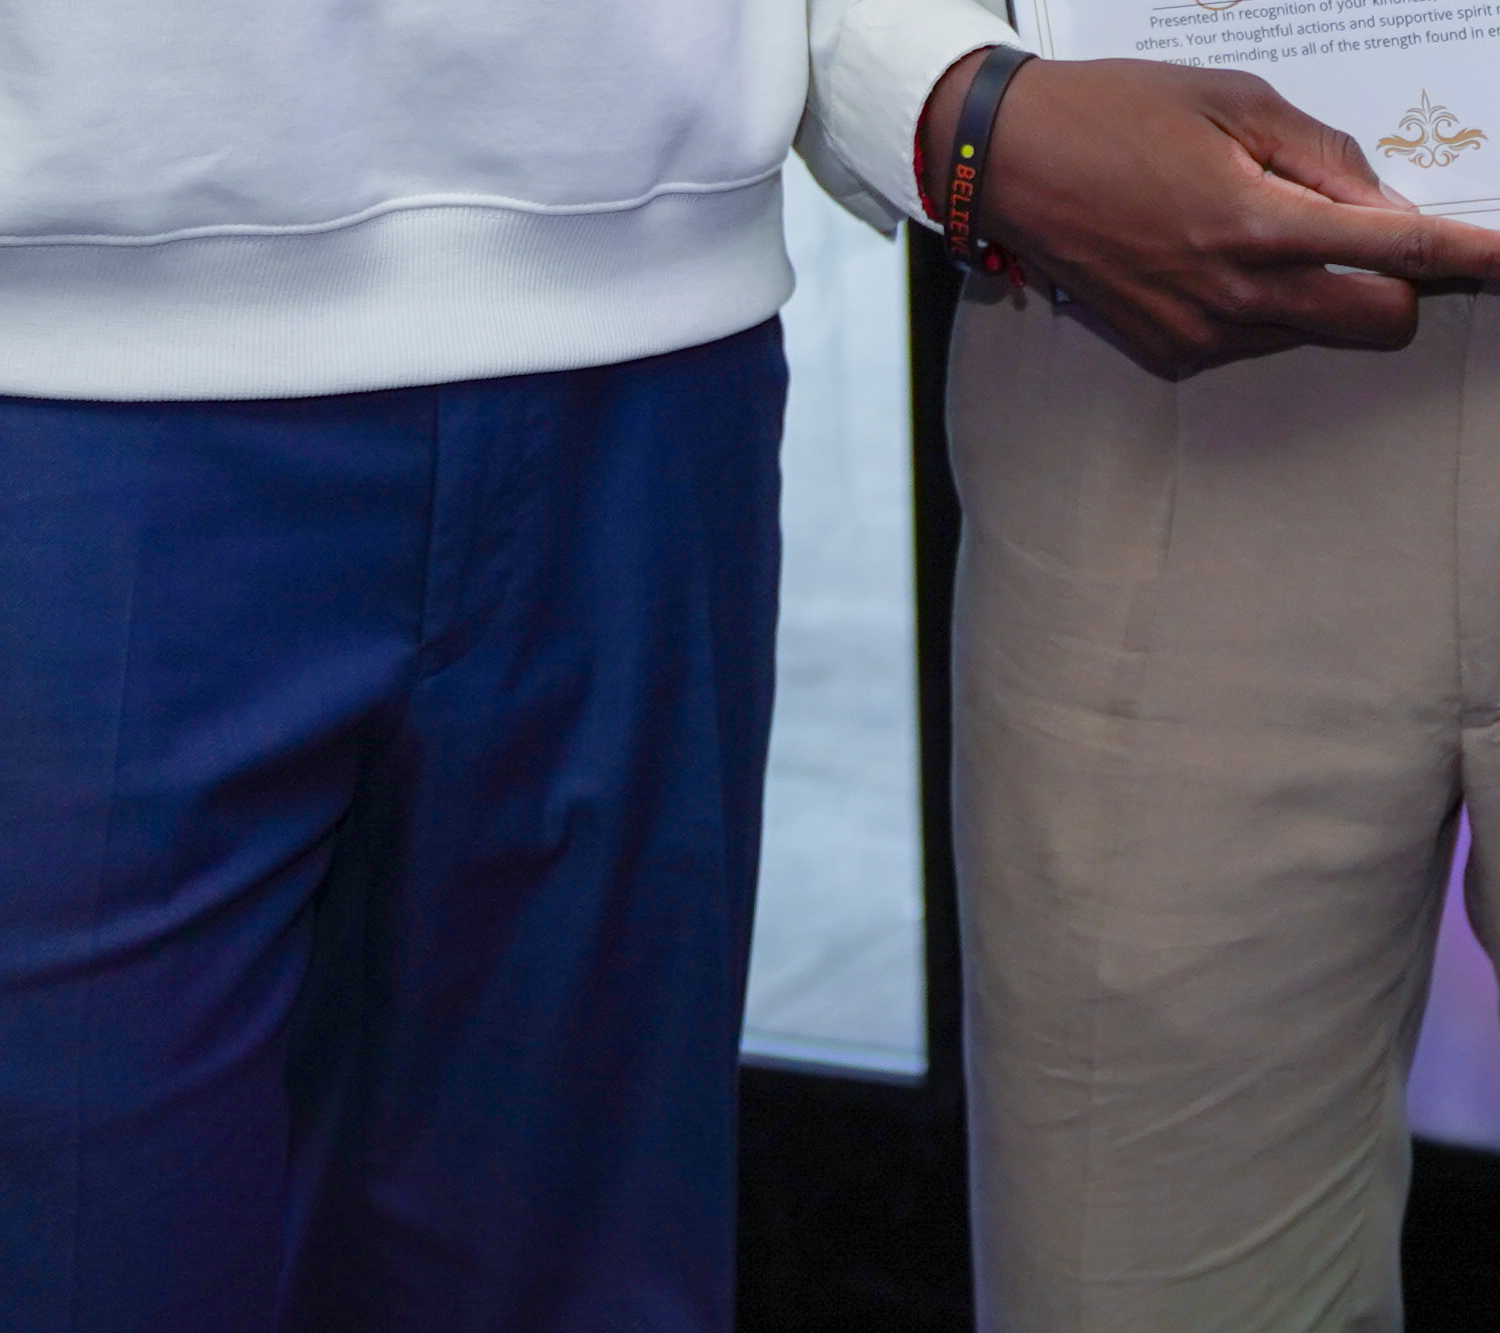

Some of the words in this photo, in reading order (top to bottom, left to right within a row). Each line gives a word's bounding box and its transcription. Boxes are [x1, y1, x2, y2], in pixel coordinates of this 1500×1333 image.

[1135, 36, 1184, 52] others.
[1186, 33, 1217, 48] Your
[1221, 23, 1294, 44] thoughtful
[1296, 20, 1346, 37] actions
[1349, 15, 1376, 31] and
[1379, 8, 1453, 29] supportive
[1457, 4, 1493, 24] spirit
[1150, 9, 1219, 29] Presented
[1222, 8, 1235, 22] in
[1238, 2, 1317, 21] recognition
[1319, 0, 1334, 15] of
[1335, 0, 1368, 15] your
[1160, 55, 1205, 68] roup,
[1208, 47, 1279, 64] reminding
[1281, 46, 1299, 58] us
[1301, 42, 1318, 56] all
[1320, 39, 1335, 54] of
[1337, 37, 1361, 52] the
[1364, 31, 1422, 50] strength
[1426, 26, 1467, 43] found
[1470, 27, 1485, 40] in
